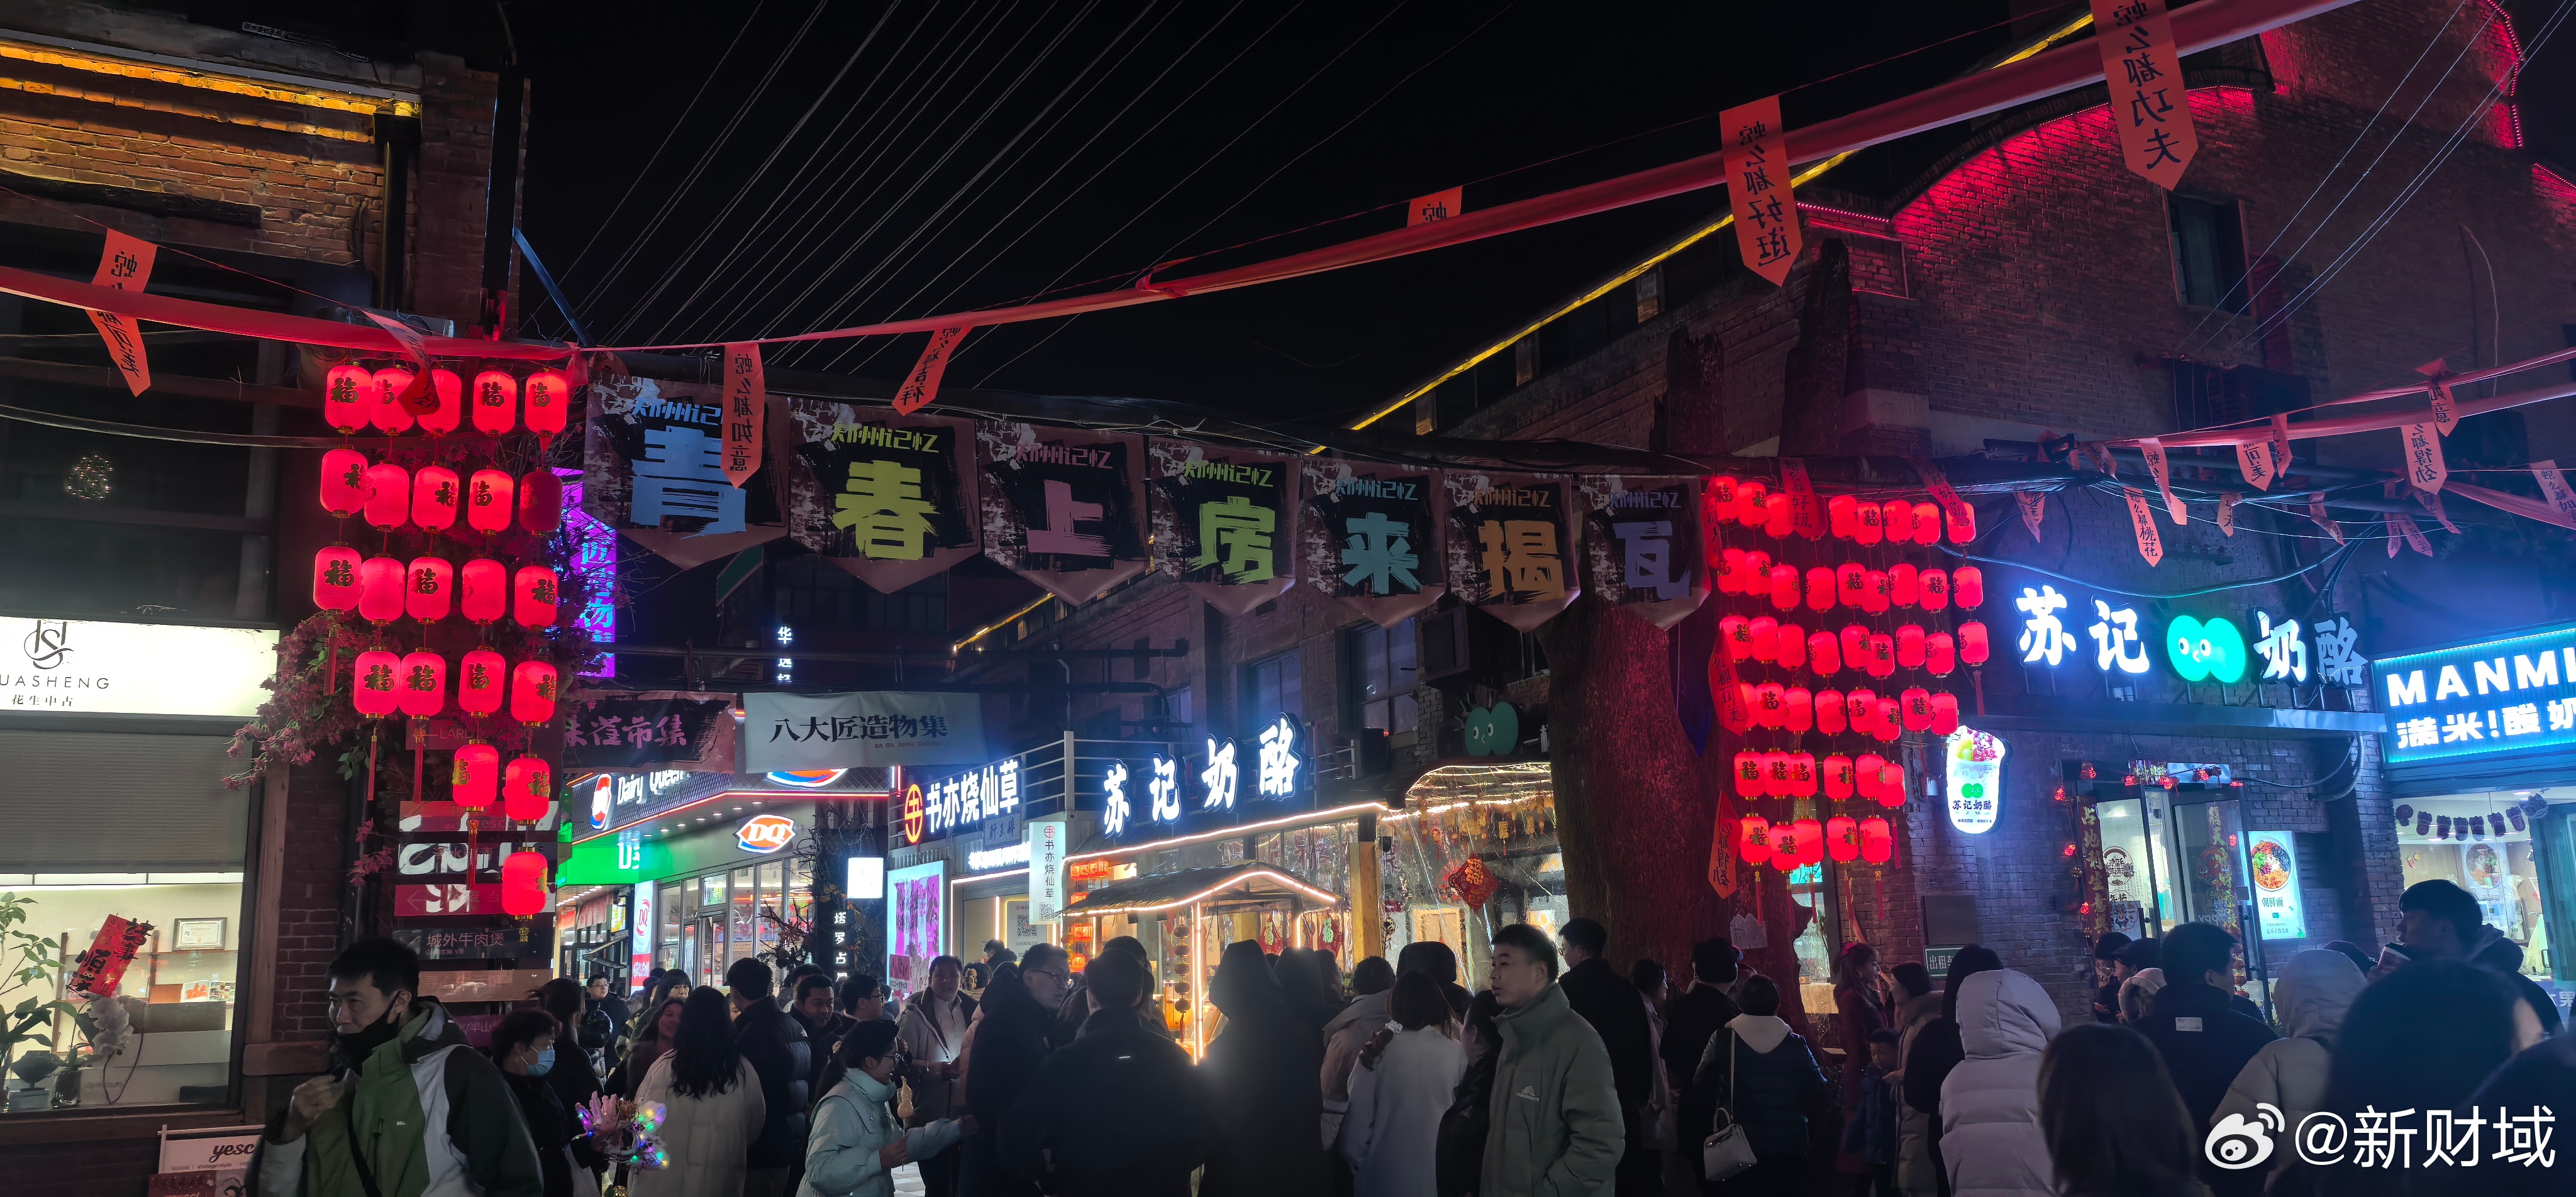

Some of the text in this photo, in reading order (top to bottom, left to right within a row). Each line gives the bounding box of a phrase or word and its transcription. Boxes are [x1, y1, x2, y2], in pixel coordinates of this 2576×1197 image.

[331, 377, 358, 403] 福
[482, 382, 505, 407] 福
[631, 397, 723, 428] 郑州记
[831, 424, 939, 453] 郑州记忆
[1016, 443, 1113, 469] 郑州记忆
[630, 426, 746, 539] 青
[1184, 461, 1274, 487] 郑州记忆
[1335, 477, 1418, 501] 郑州记忆
[1473, 488, 1552, 508] 郑州记忆
[1609, 490, 1682, 510] 郑州记忆
[833, 460, 947, 561] 春
[1027, 479, 1117, 557] 上
[1189, 496, 1275, 586] 房
[1341, 512, 1423, 594] 来
[324, 560, 355, 587] 福
[1478, 519, 1565, 605] 揭
[1613, 520, 1692, 600] 瓦
[411, 568, 439, 595] 福
[531, 579, 556, 605] 福
[1927, 576, 1945, 593] 福
[364, 664, 395, 692] 福
[406, 665, 437, 692] 福
[2387, 647, 2576, 707] MANMI
[11, 694, 74, 707] 花生中古
[769, 714, 948, 743] 八大匠造物集
[1104, 717, 1299, 835] 苏记奶酪
[1740, 761, 1760, 781] 福
[1770, 761, 1789, 781] 福
[617, 775, 643, 805] Dairy
[925, 759, 1019, 833] 书亦烧仙草
[1952, 799, 1992, 810] 苏记奶酪
[747, 823, 787, 844] DQ
[1045, 840, 1055, 898] 书亦烧仙草
[426, 933, 504, 947] 城外牛肉煲
